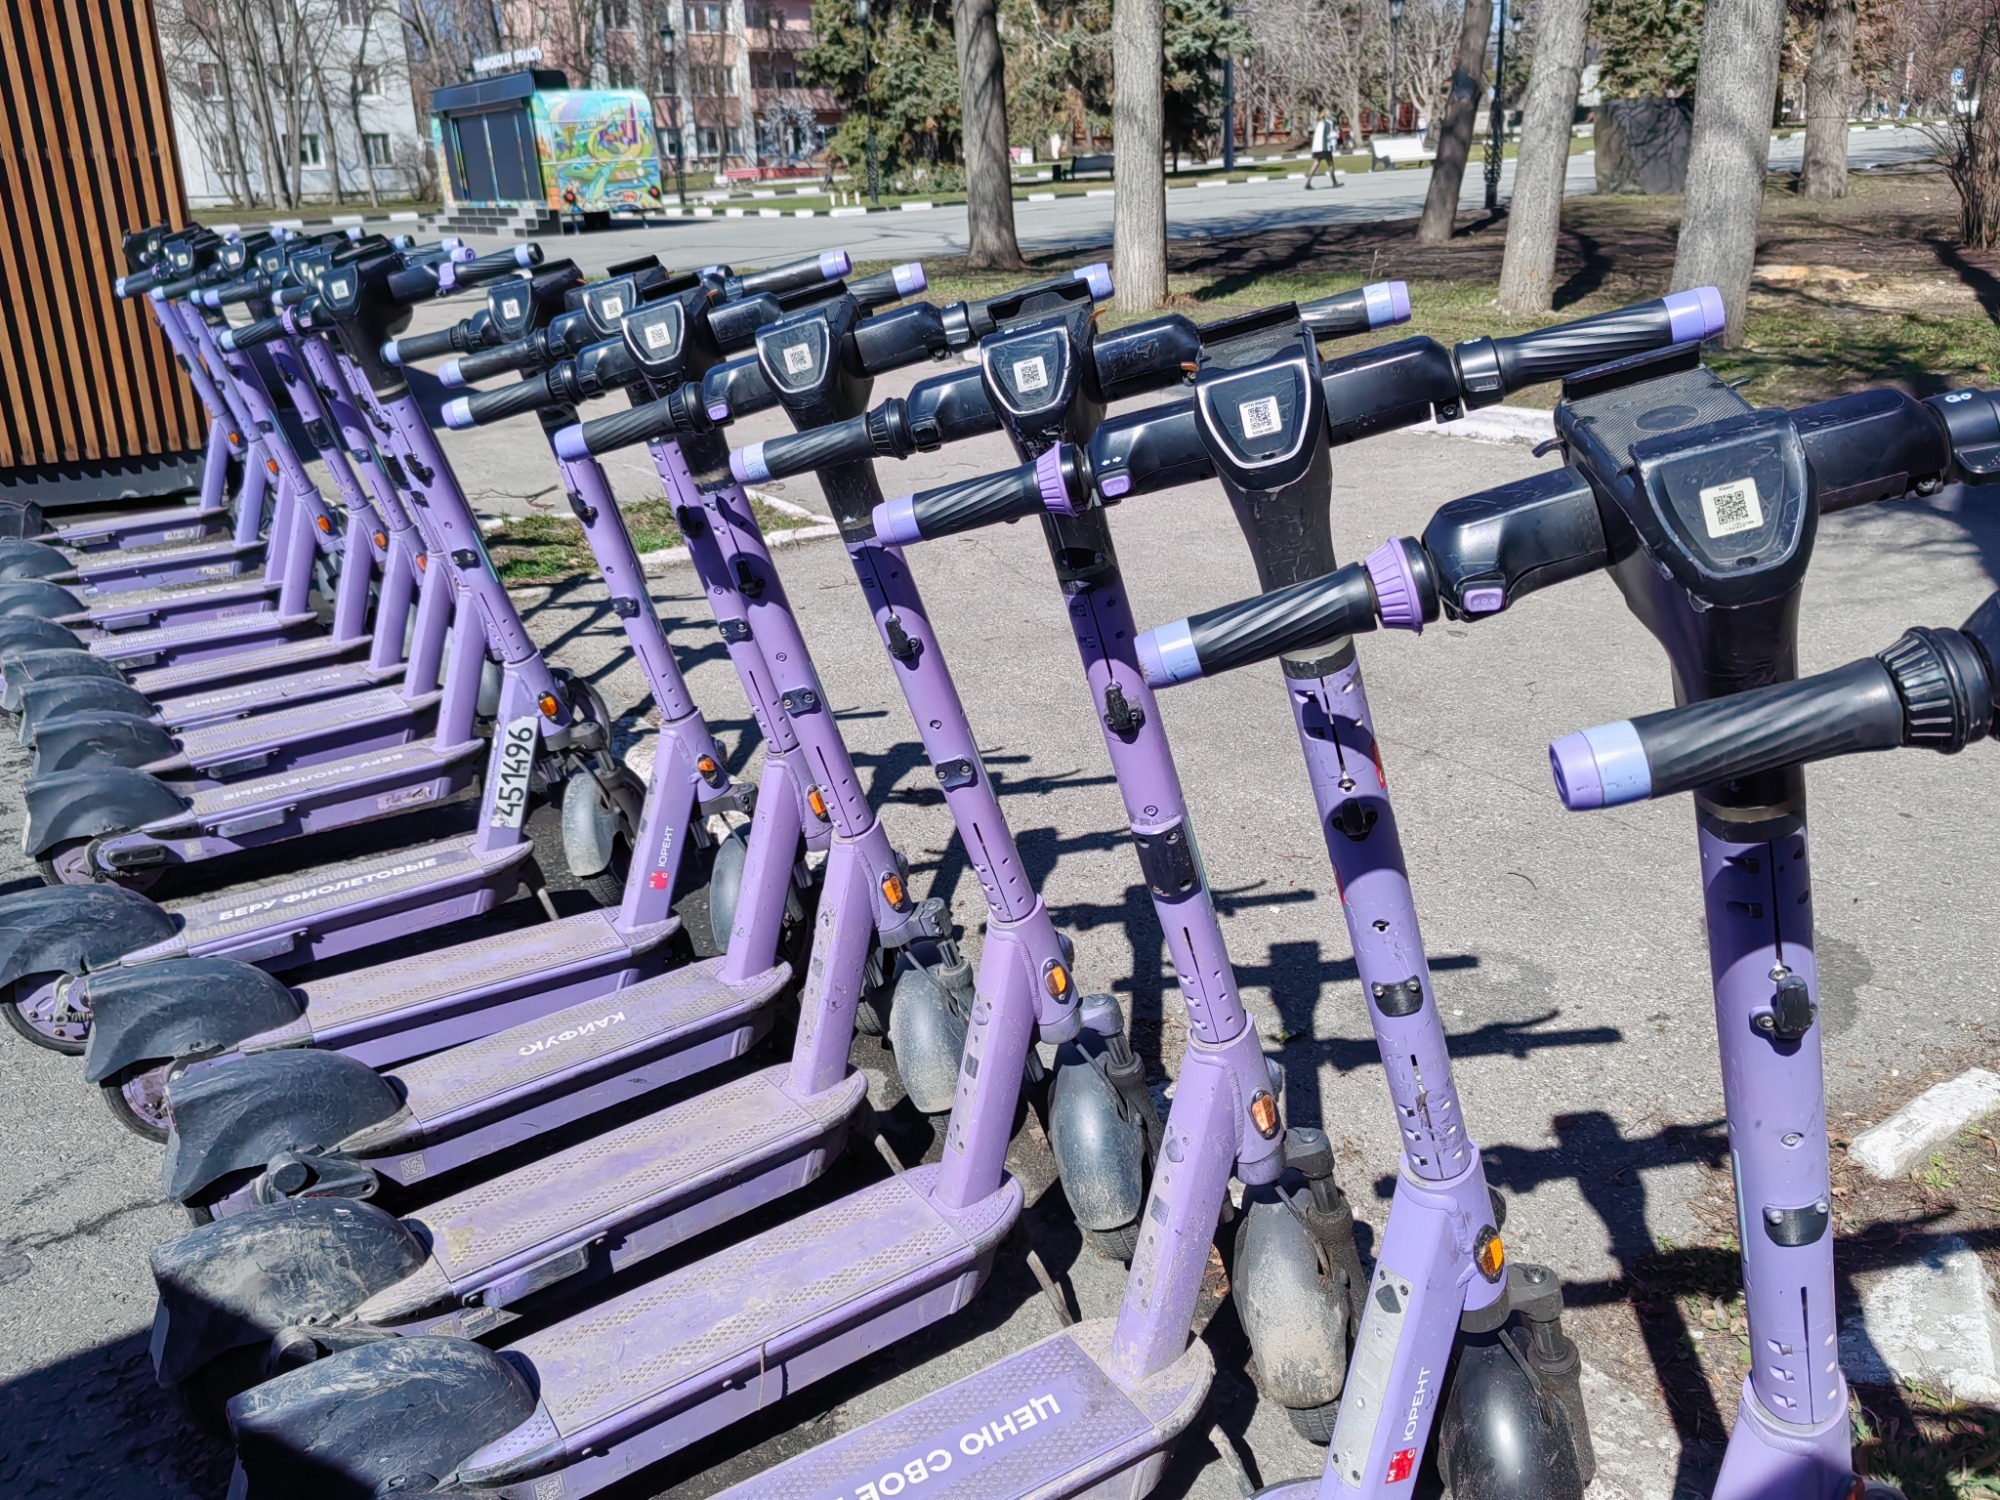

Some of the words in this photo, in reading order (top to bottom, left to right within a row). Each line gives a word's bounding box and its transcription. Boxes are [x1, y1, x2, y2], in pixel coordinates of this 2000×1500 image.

[223, 764, 356, 801] ФИОЛЕТОВЫЕ
[359, 753, 404, 769] БЕРУ
[498, 727, 534, 818] 451496
[657, 824, 675, 868] ЮРЕНТ
[219, 898, 278, 921] БЕРУ
[282, 857, 438, 904] ФИОЛЕТОВЫЕ
[518, 1011, 626, 1056] КАЙФУЮ
[958, 1393, 1062, 1456] ЦЕНЮ
[1402, 1366, 1431, 1442] ЮРЕНТ
